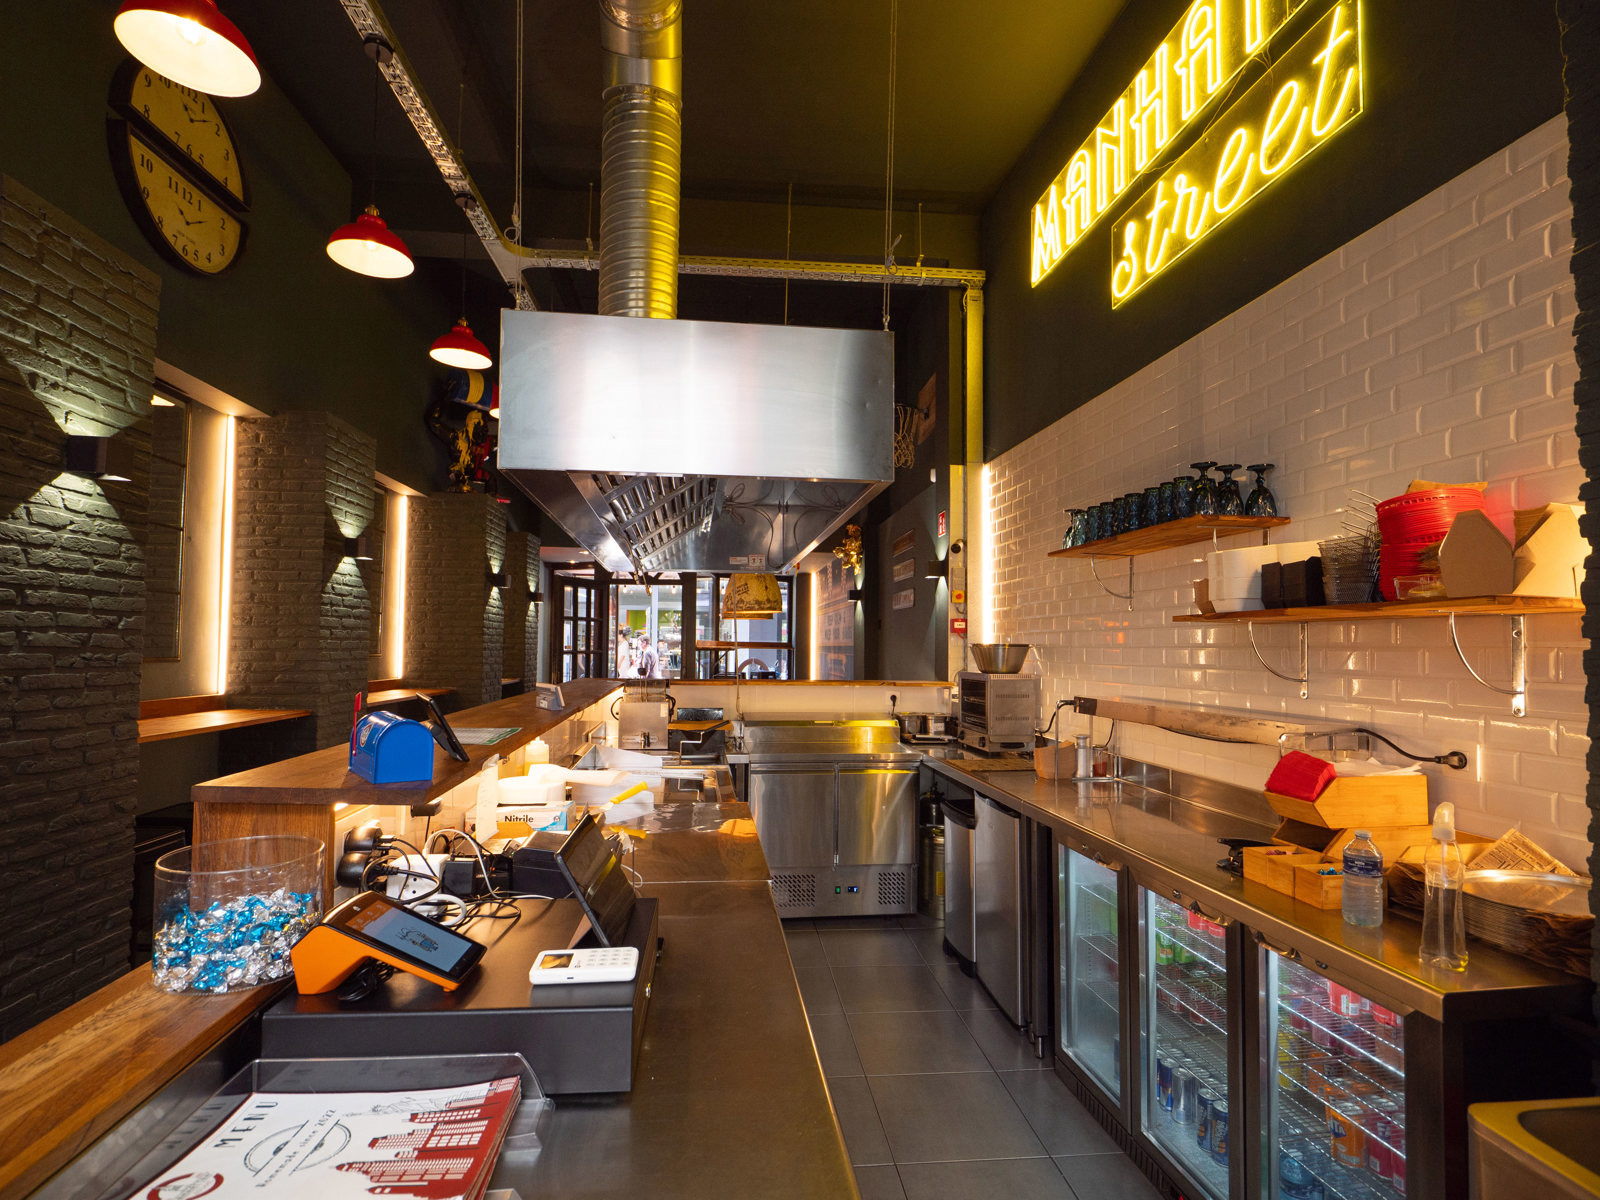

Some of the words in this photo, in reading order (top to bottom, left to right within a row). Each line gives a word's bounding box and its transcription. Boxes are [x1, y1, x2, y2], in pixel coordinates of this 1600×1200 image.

[144, 74, 152, 87] 9
[143, 104, 150, 119] 8
[215, 124, 221, 137] 2
[174, 131, 181, 144] 7
[186, 144, 193, 156] 6
[223, 149, 230, 161] 3
[1112, 5, 1356, 298] street
[139, 153, 153, 173] 10
[167, 175, 179, 194] 11
[222, 176, 229, 188] 4
[142, 186, 150, 201] 9
[182, 187, 193, 205] 12
[197, 199, 202, 212] 1
[156, 215, 164, 229] 8
[219, 217, 226, 231] 2
[172, 234, 179, 247] 7
[181, 244, 189, 257] 6
[193, 249, 200, 262] 5
[218, 244, 226, 257] 3
[205, 252, 212, 264] 4
[504, 814, 534, 823] Nitrile
[213, 1101, 279, 1148] MENU
